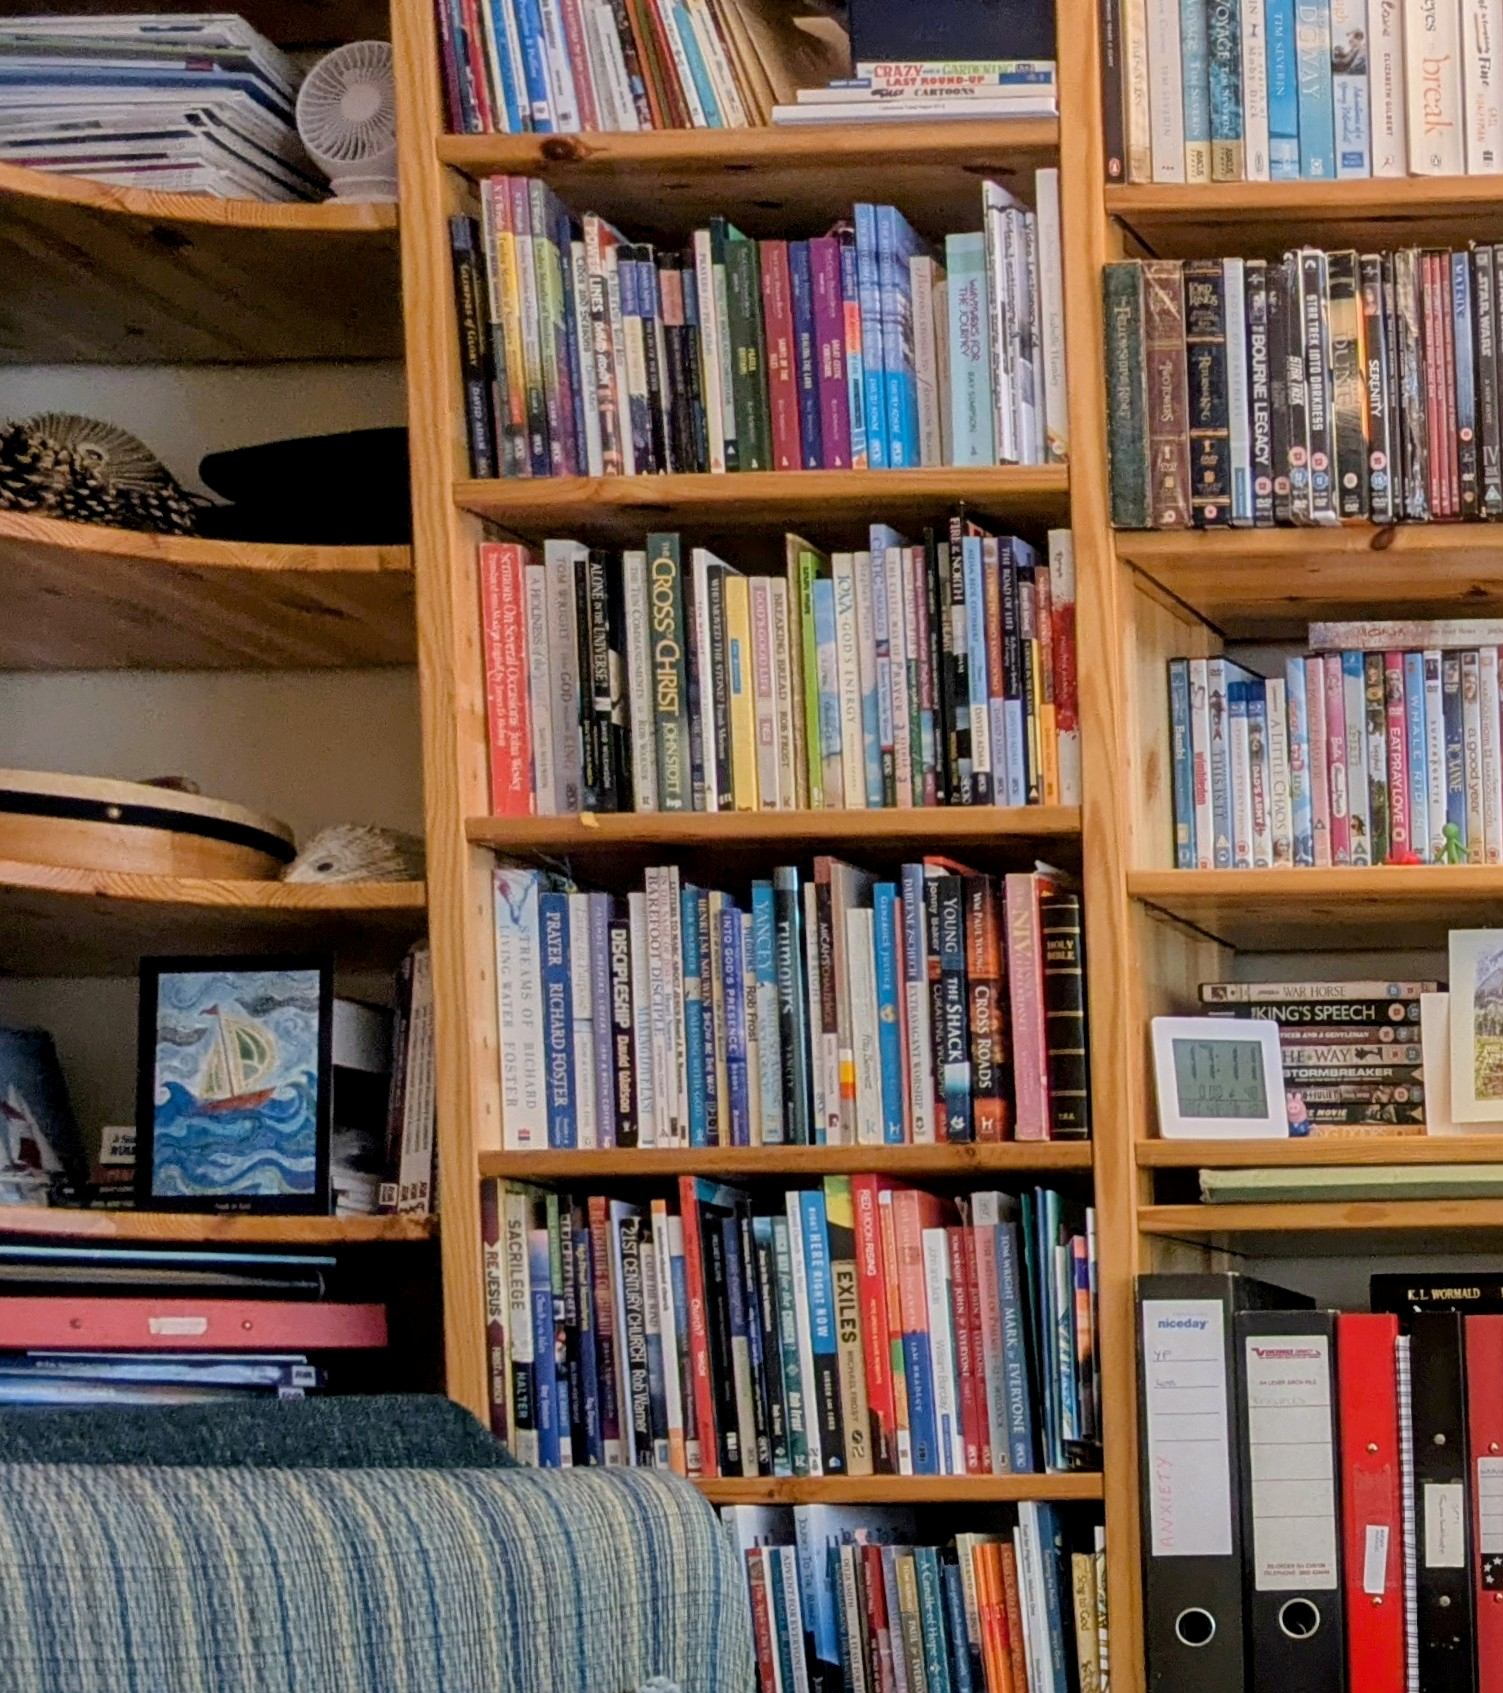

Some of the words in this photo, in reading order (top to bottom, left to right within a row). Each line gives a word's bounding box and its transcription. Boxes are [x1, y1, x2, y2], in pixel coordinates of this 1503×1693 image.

[874, 65, 923, 78] CRAZY
[886, 77, 917, 87] LAST
[1423, 55, 1454, 136] break
[589, 278, 604, 313] LINES
[1478, 273, 1490, 314] STAR
[1480, 317, 1493, 356] WARS
[1251, 334, 1266, 400] BOURNE
[1369, 360, 1382, 417] SERENITY
[471, 387, 483, 420] DAVID
[968, 392, 978, 433] SIMPSON
[1310, 376, 1323, 431] DARKNESS
[1254, 402, 1269, 465] LEGACY
[500, 552, 517, 604] Sermons
[589, 563, 605, 600] ALONE
[651, 557, 677, 632] CROSS
[950, 556, 964, 601] NORTH
[557, 588, 571, 642] WRIGHT
[774, 593, 786, 656] BREAKING
[504, 625, 519, 664] Several
[592, 626, 608, 688] UNIVERSE?
[506, 668, 521, 726] Occasions
[560, 671, 574, 703] GOD
[655, 639, 680, 716] CHRIST
[776, 659, 788, 701] BREAD
[662, 723, 678, 750] JOHN
[1410, 696, 1422, 760] WHALE
[664, 751, 681, 793] STOTT
[974, 737, 986, 768] ADAM
[1466, 741, 1480, 779] good
[1468, 783, 1480, 816] year
[647, 876, 661, 961] BAREFOOT
[927, 882, 941, 914] Jonny
[546, 912, 562, 966] PRAYER
[723, 915, 733, 944] INTO
[756, 901, 773, 972] YANCEY
[930, 917, 942, 951] Baker
[943, 897, 958, 953] YOUNG
[1013, 911, 1031, 958] NIV
[501, 925, 513, 974] LIVING
[518, 926, 533, 1001] STREAMS
[724, 947, 735, 985] GOD'S
[778, 921, 795, 1014] rumours
[611, 930, 630, 1029] DISCIPLESHIP
[650, 967, 665, 1037] DISCIPLE
[745, 986, 757, 1009] Rob
[947, 977, 959, 1001] THE
[1283, 986, 1306, 998] WAR
[1311, 986, 1347, 998] HORSE
[502, 982, 514, 1028] WATER
[522, 1008, 533, 1028] OF
[549, 983, 565, 1049] RICHARD
[726, 990, 737, 1051] PRESENCE
[747, 1012, 758, 1043] Frost
[973, 986, 990, 1034] CROSS
[1255, 1005, 1312, 1020] KING'S
[1315, 1005, 1375, 1020] SPEECH
[947, 1004, 962, 1061] SHACK
[503, 1043, 518, 1108] FOSTER
[523, 1043, 537, 1109] RICHARD
[551, 1053, 568, 1106] FOSTER
[977, 1039, 992, 1089] ROADS
[1282, 1050, 1305, 1064] HE
[1315, 1049, 1351, 1063] WAY
[860, 1189, 873, 1209] RED
[619, 1227, 634, 1256] 21ST
[810, 1233, 824, 1267] HERE
[864, 1242, 877, 1277] RISING
[508, 1220, 525, 1310] SACRILEGE
[623, 1258, 638, 1313] CENTURY
[812, 1270, 824, 1305] RIGHT
[836, 1271, 857, 1344] EXILES
[1431, 1288, 1480, 1300] WORMALD
[630, 1316, 646, 1363] CHURCH
[815, 1308, 829, 1338] NOW
[1003, 1307, 1018, 1346] MARK
[1158, 1318, 1206, 1331] niceday
[515, 1372, 529, 1418] HALTER
[632, 1369, 646, 1390] Rob
[1007, 1363, 1025, 1434] EVERYONE
[1156, 1456, 1175, 1548] ANXIETY
